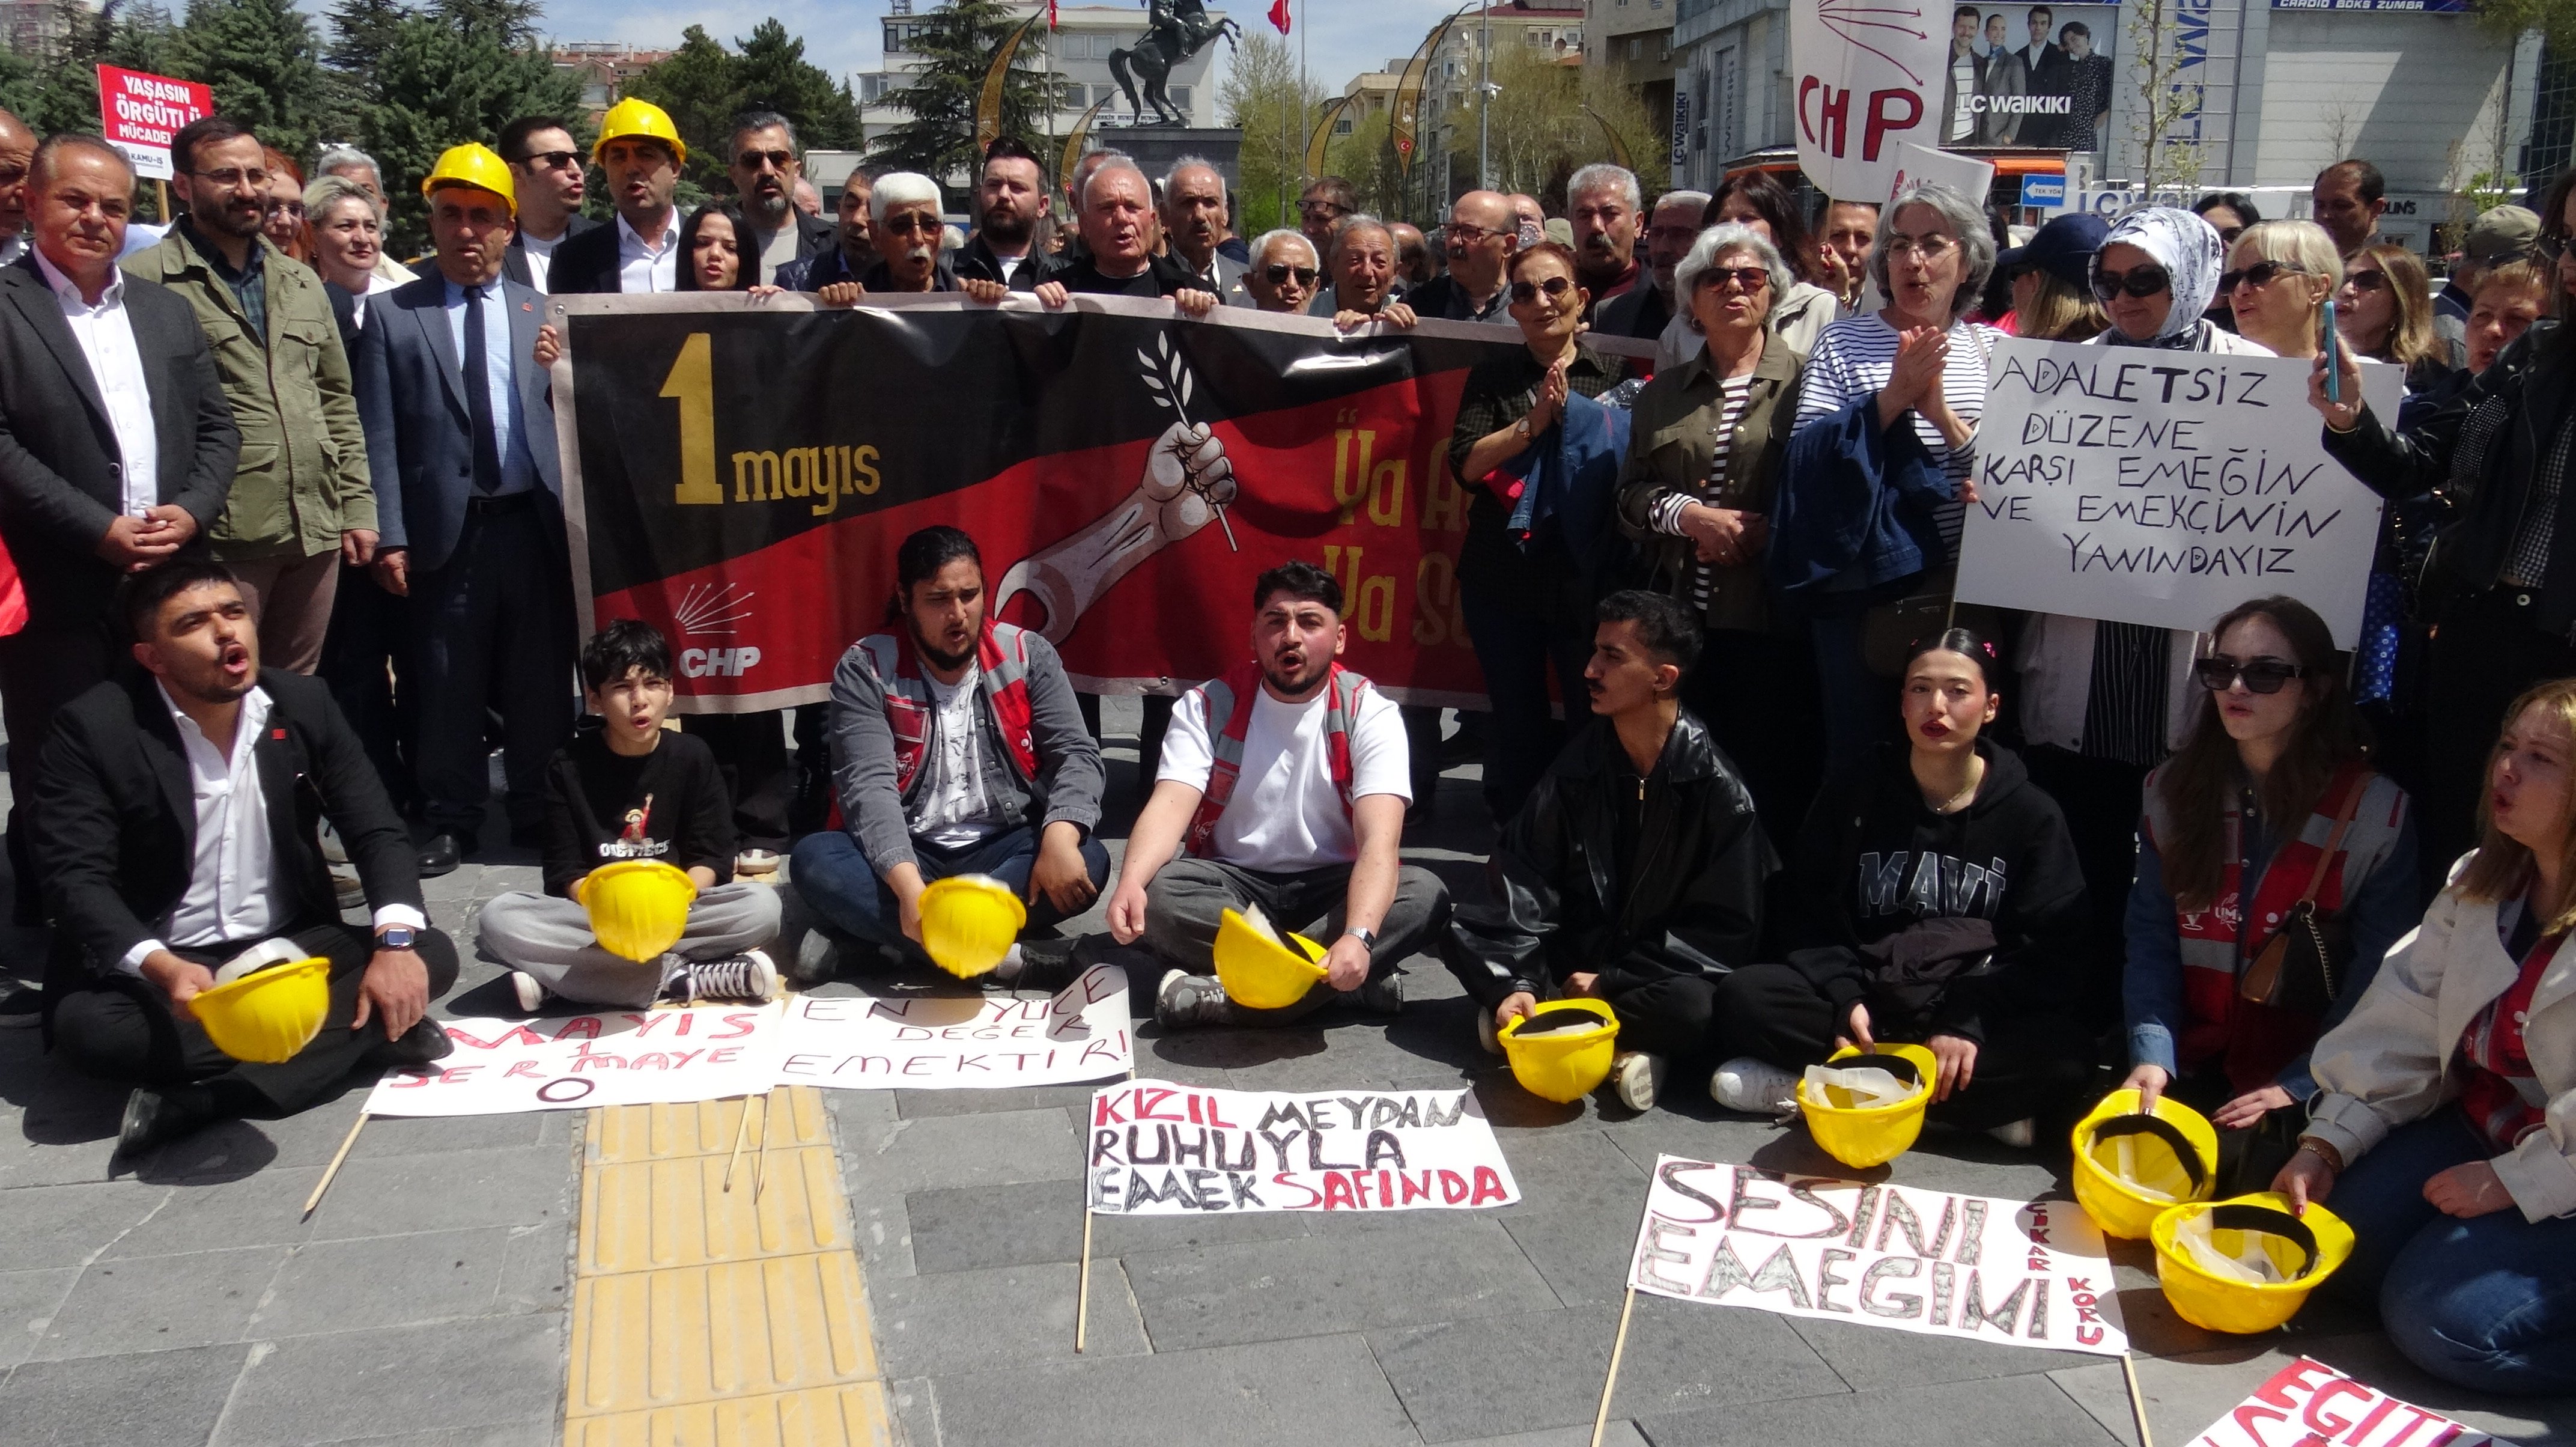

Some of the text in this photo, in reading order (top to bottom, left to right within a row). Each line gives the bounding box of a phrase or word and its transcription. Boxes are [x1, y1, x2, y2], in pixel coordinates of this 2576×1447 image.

[2377, 0, 2425, 10] ZUMBA
[123, 75, 191, 105] YAŞASIN
[1959, 94, 1987, 114] LC
[118, 121, 172, 145] MÜCADEL
[1799, 75, 1924, 162] CHP
[1992, 355, 2269, 407] ADALETSİZ
[658, 332, 881, 516] 1 mayıs
[2022, 410, 2204, 450] DÜZENE
[1983, 448, 2324, 496] KARŞI EMEĞİN
[1981, 496, 2032, 522] VE
[2062, 532, 2295, 577] YANINDAYIZ
[679, 646, 761, 678] CHP
[803, 999, 911, 1020] EN
[892, 1014, 1092, 1041] DEĞER
[445, 1013, 759, 1051] MAYIS
[1095, 1088, 1467, 1132] KIZIL MEYDAN
[1092, 1123, 1406, 1172] RUHUYLA
[1090, 1165, 1509, 1213] EMEK SAFINDA
[2067, 1276, 2105, 1346] KORU
